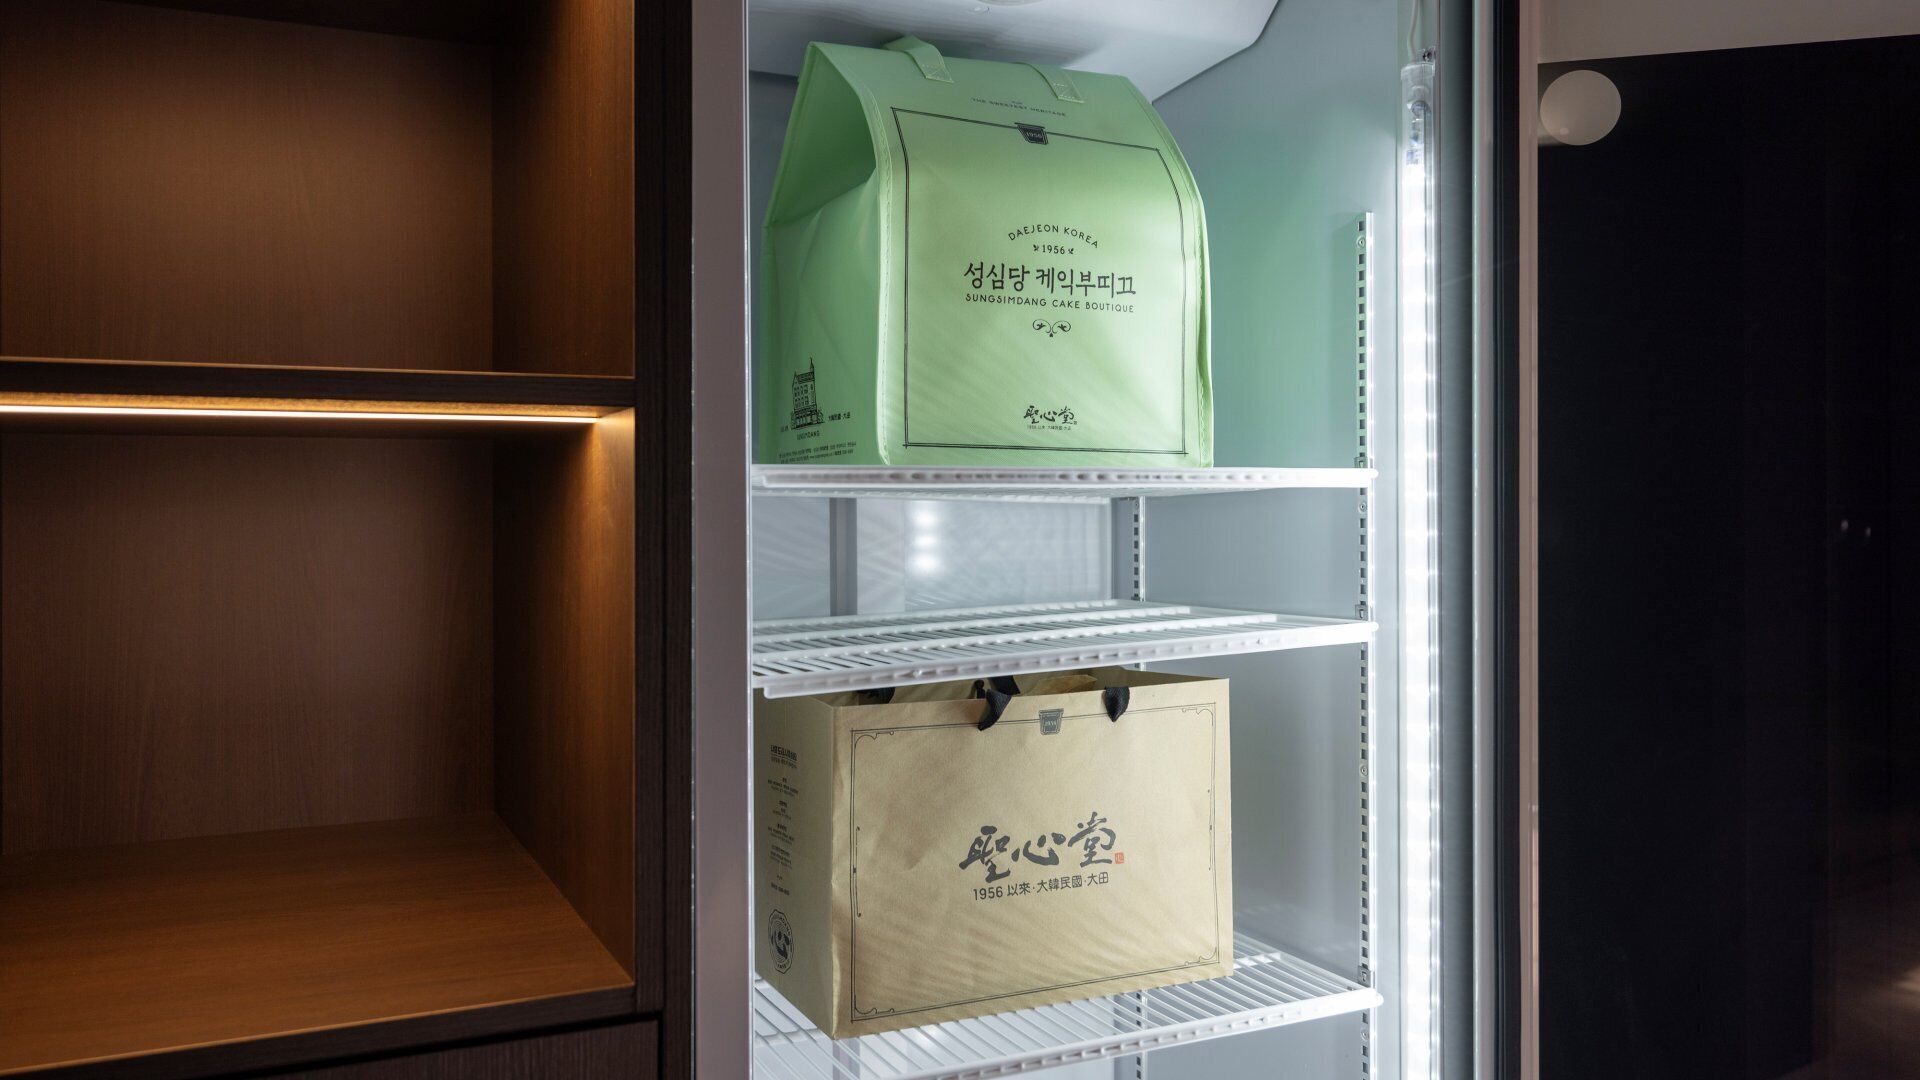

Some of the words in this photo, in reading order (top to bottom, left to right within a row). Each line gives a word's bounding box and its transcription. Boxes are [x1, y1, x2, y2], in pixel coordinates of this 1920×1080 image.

[1008, 224, 1059, 241] DAEJEON
[1063, 227, 1098, 249] KOREA
[1042, 244, 1065, 255] 1956
[963, 261, 1031, 292] 성심당
[1035, 266, 1136, 298] 케익부띠끄
[965, 293, 1047, 307] SUNGSIMDANG
[1052, 300, 1080, 309] CAKE
[1085, 302, 1134, 313] BOUTIQUE
[958, 811, 1117, 883] 聖心堂
[973, 886, 1004, 901] 1956
